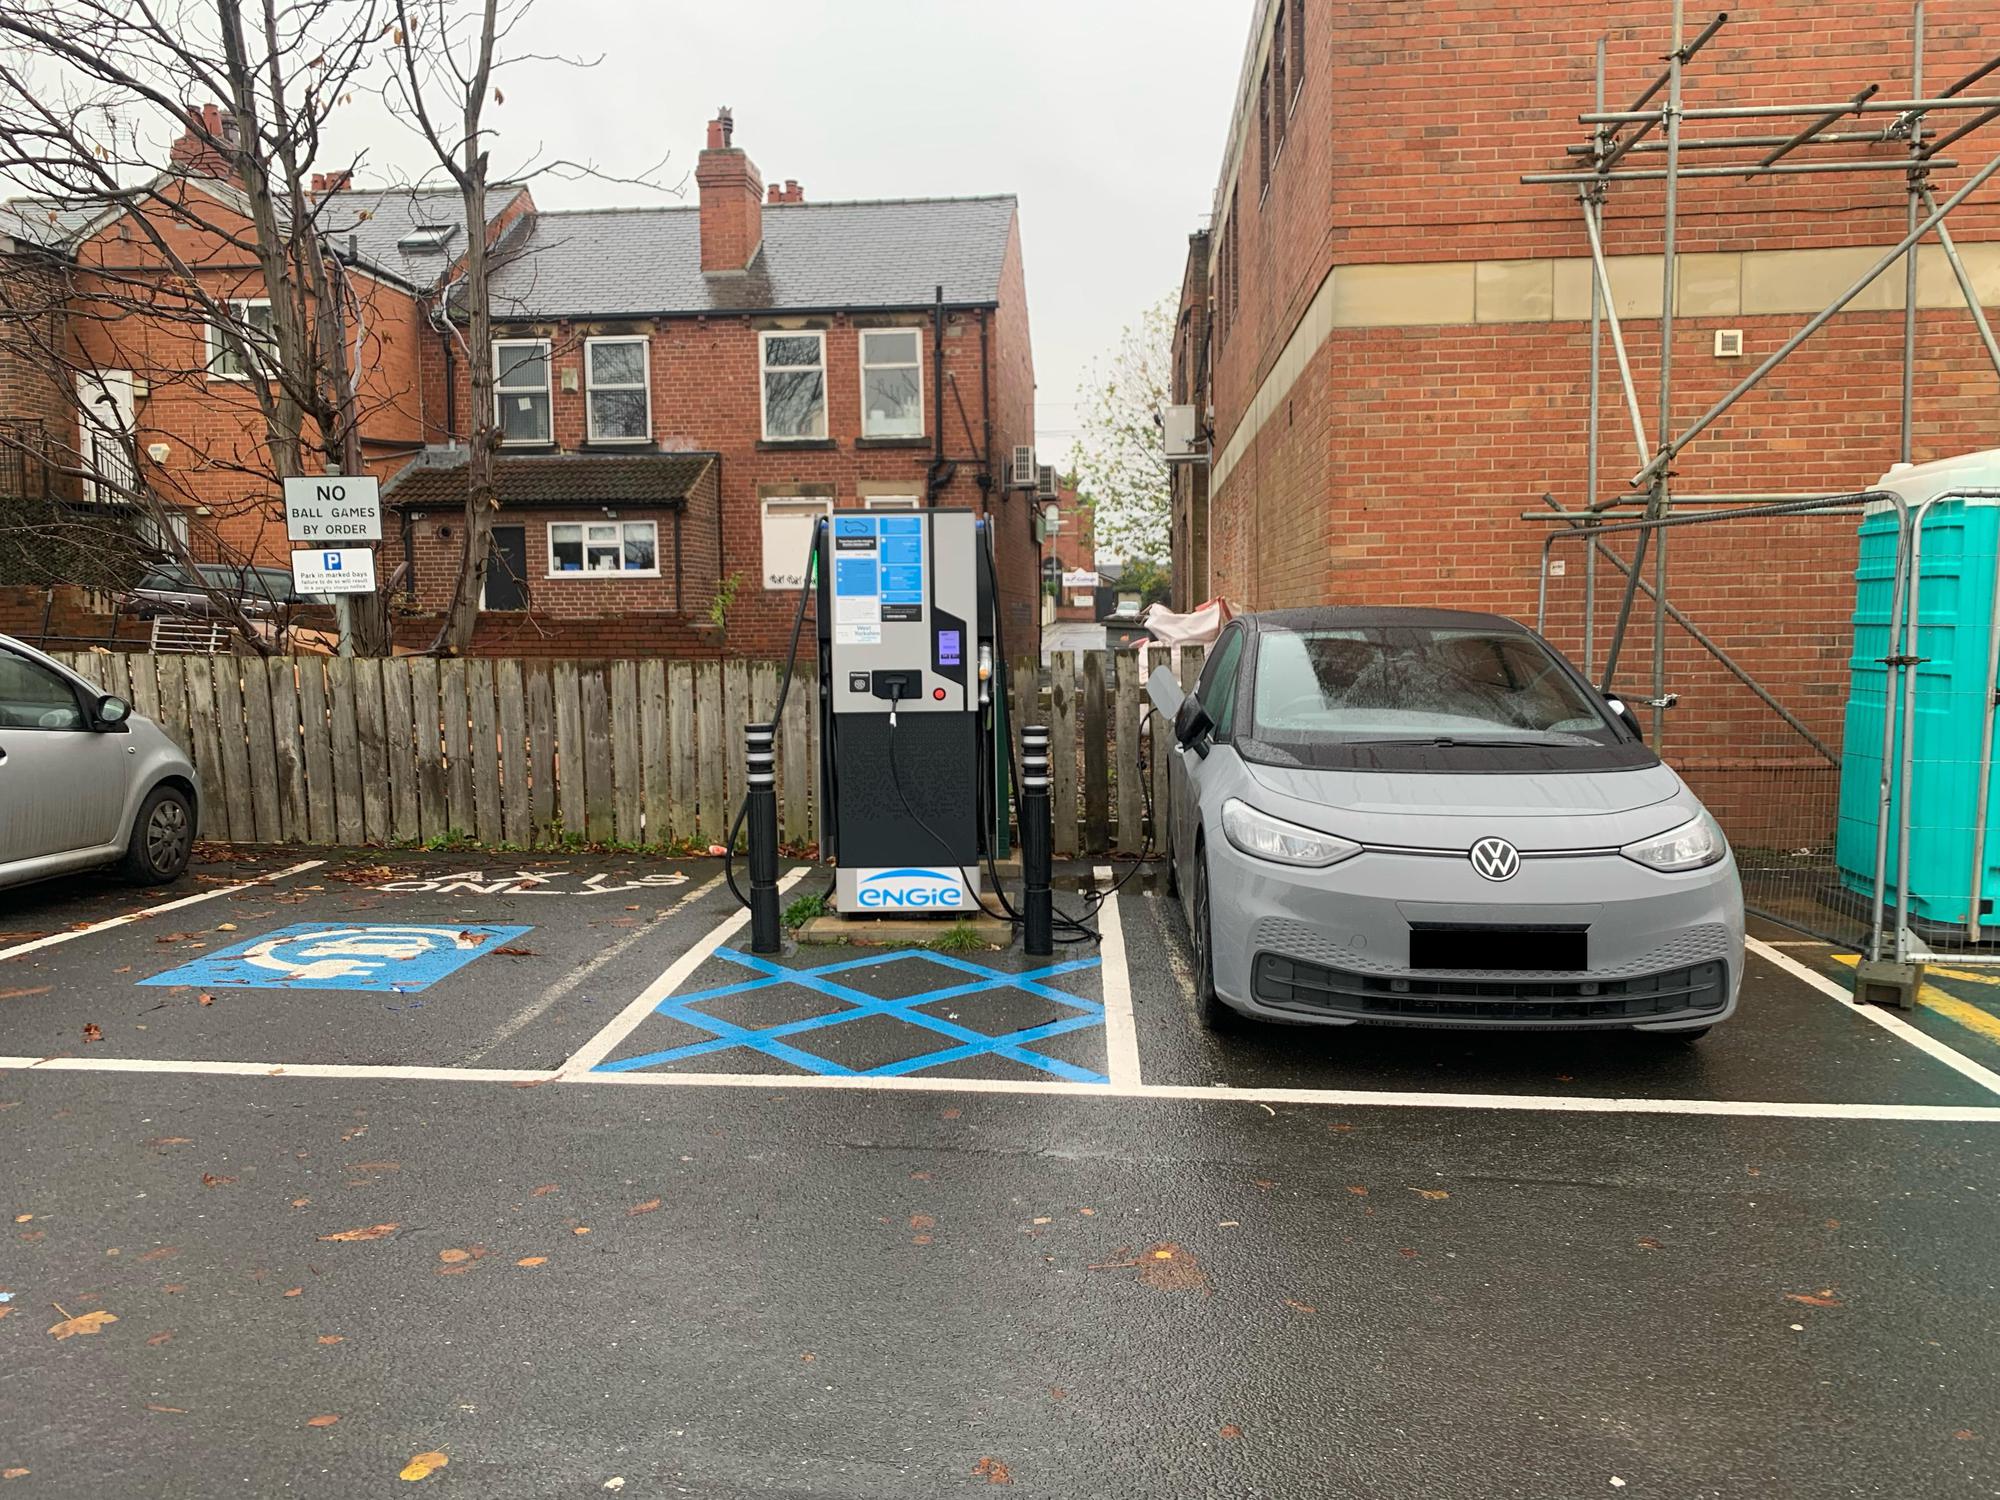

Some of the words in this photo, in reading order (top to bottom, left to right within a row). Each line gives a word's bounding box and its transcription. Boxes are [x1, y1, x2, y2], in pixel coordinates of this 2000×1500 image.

[316, 485, 346, 501] NO
[292, 508, 323, 518] BALL
[331, 507, 375, 518] GAMES
[303, 525, 319, 535] BY
[325, 524, 367, 535] ORDER
[376, 881, 641, 895] ONLY
